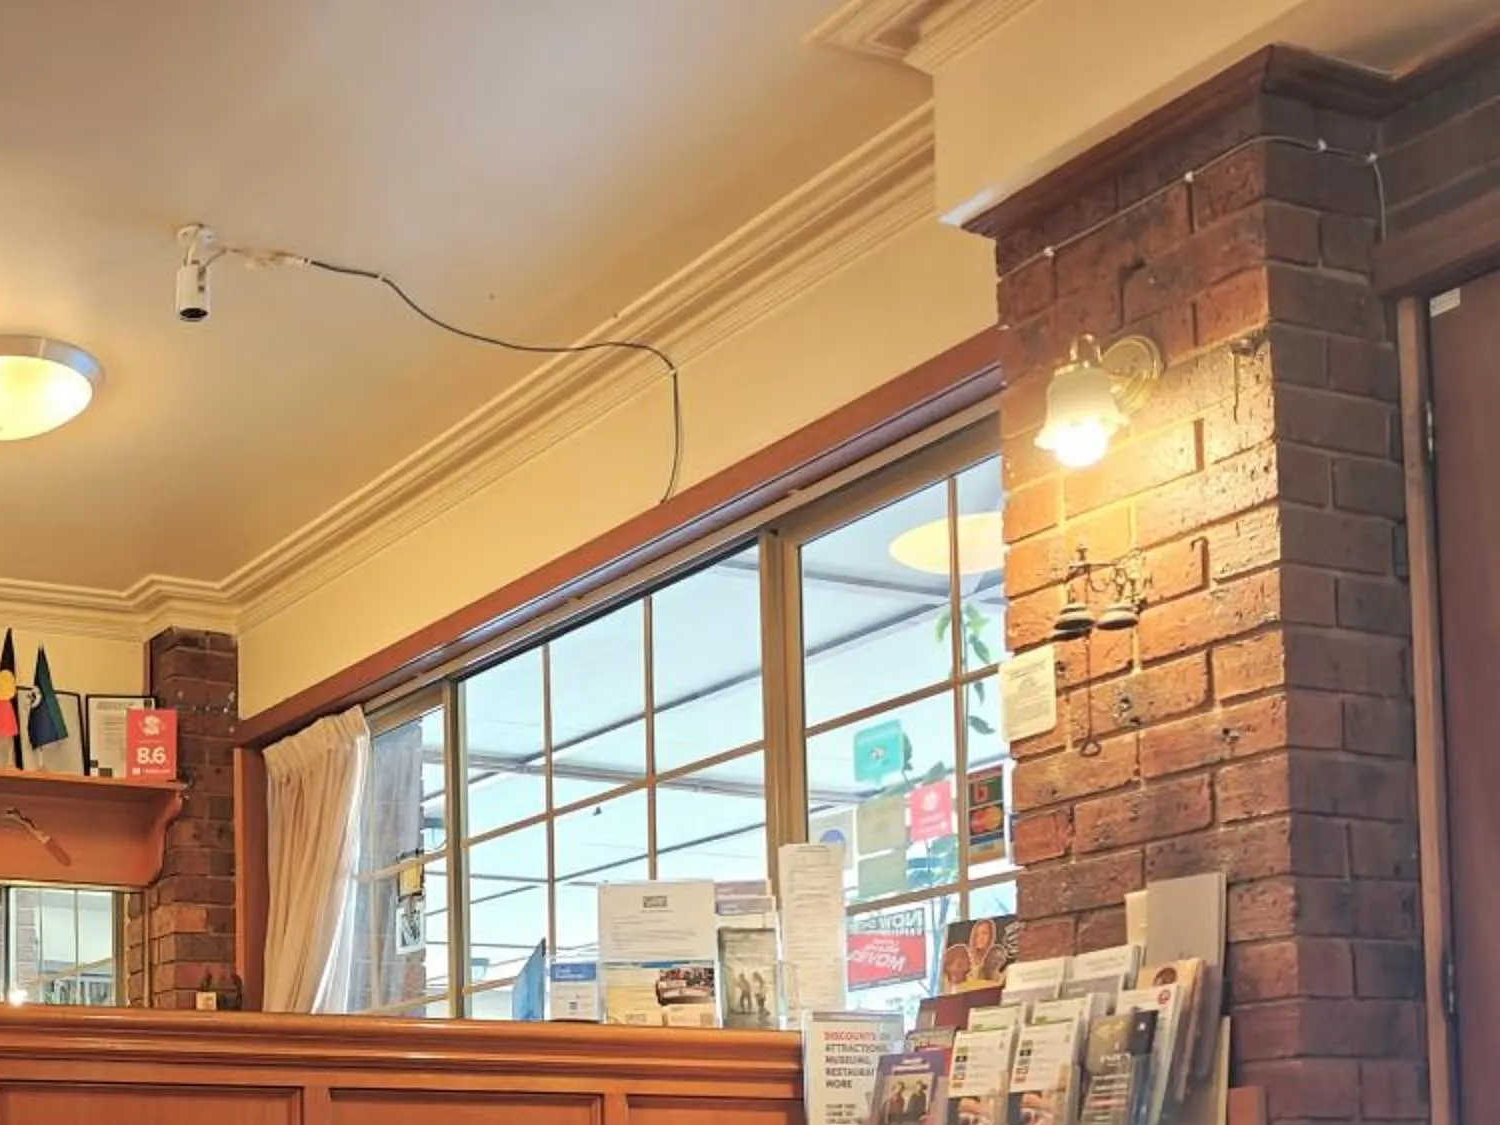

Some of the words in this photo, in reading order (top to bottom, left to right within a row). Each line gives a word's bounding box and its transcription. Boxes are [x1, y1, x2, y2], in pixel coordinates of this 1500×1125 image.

[135, 746, 167, 766] 8.6
[824, 1031, 875, 1040] DISCOUNTS
[825, 1079, 853, 1089] MORE
